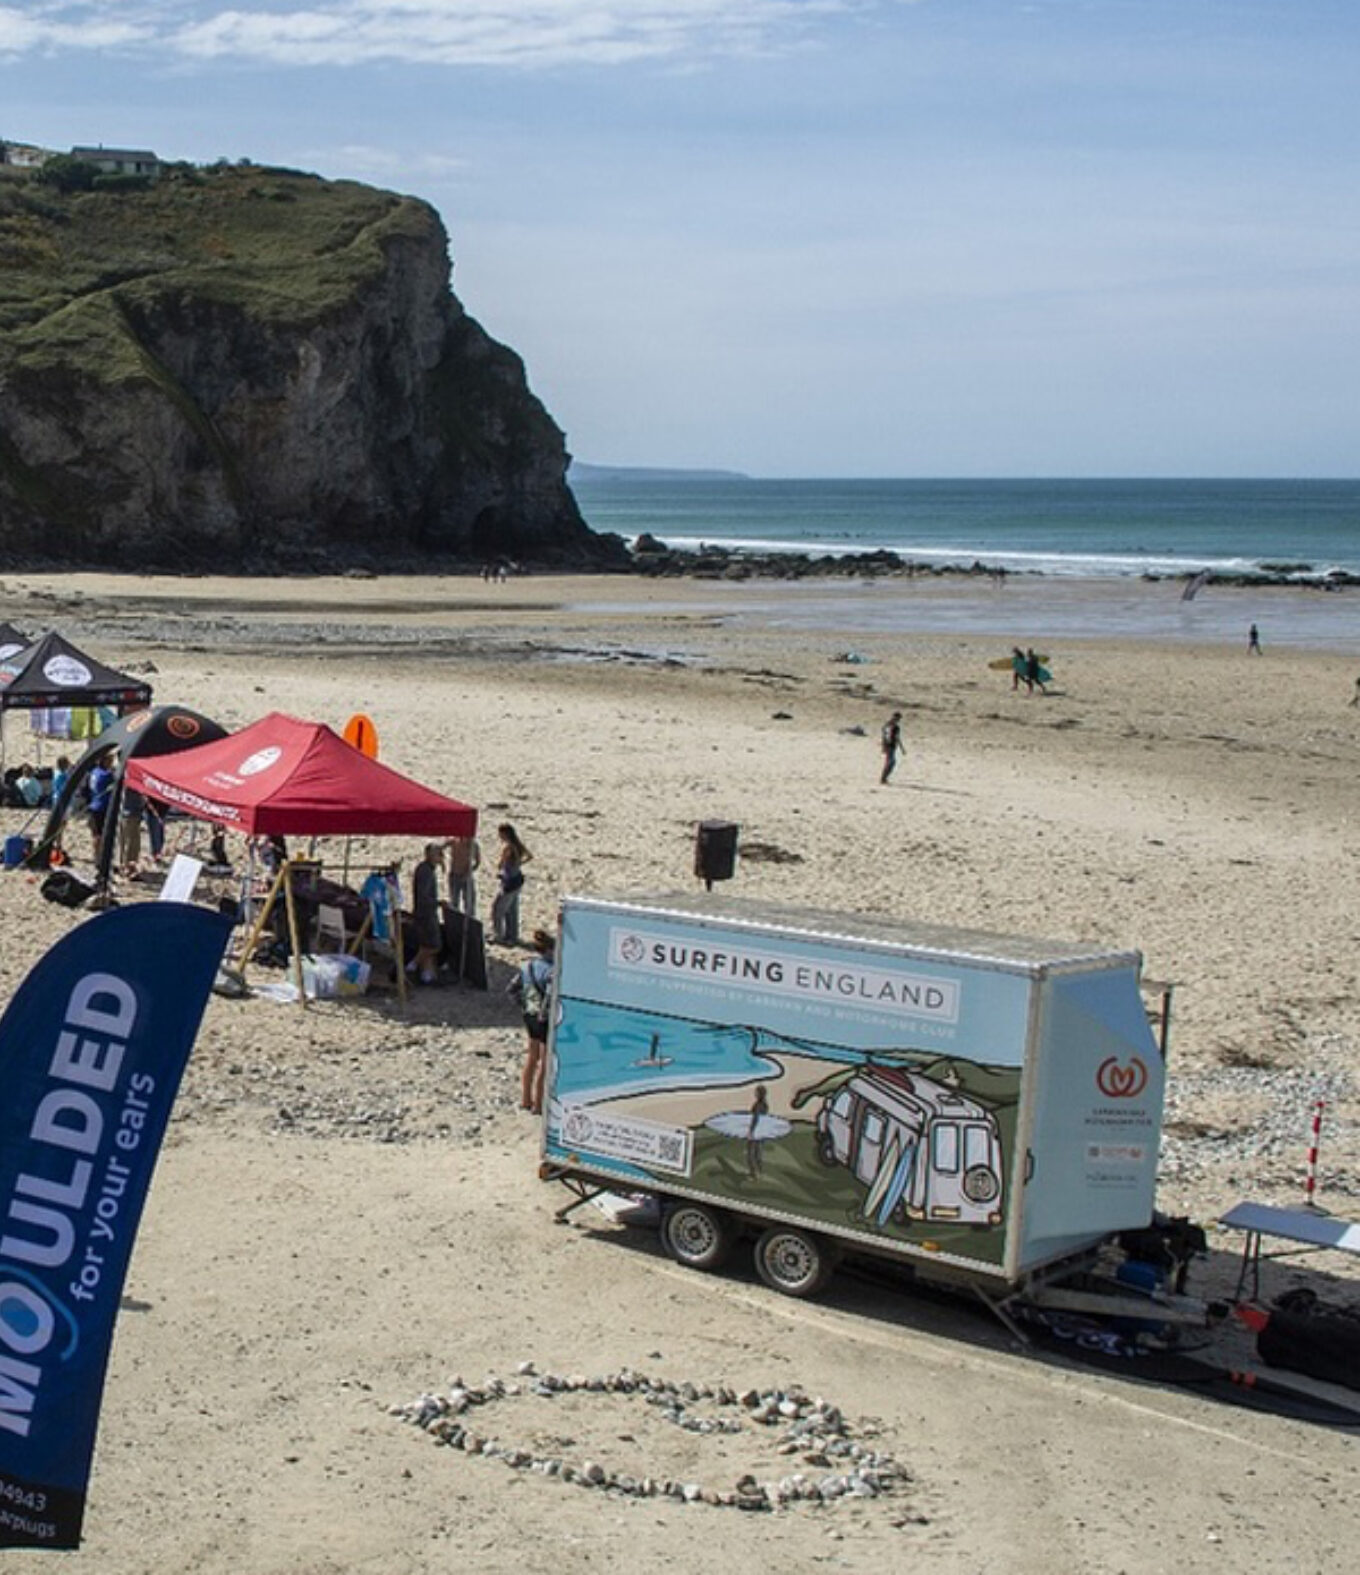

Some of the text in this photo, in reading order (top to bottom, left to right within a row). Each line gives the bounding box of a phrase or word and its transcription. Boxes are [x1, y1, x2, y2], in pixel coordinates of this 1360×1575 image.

[652, 943, 944, 1009] SURFING ENGLAND
[70, 1071, 156, 1302] for your ears
